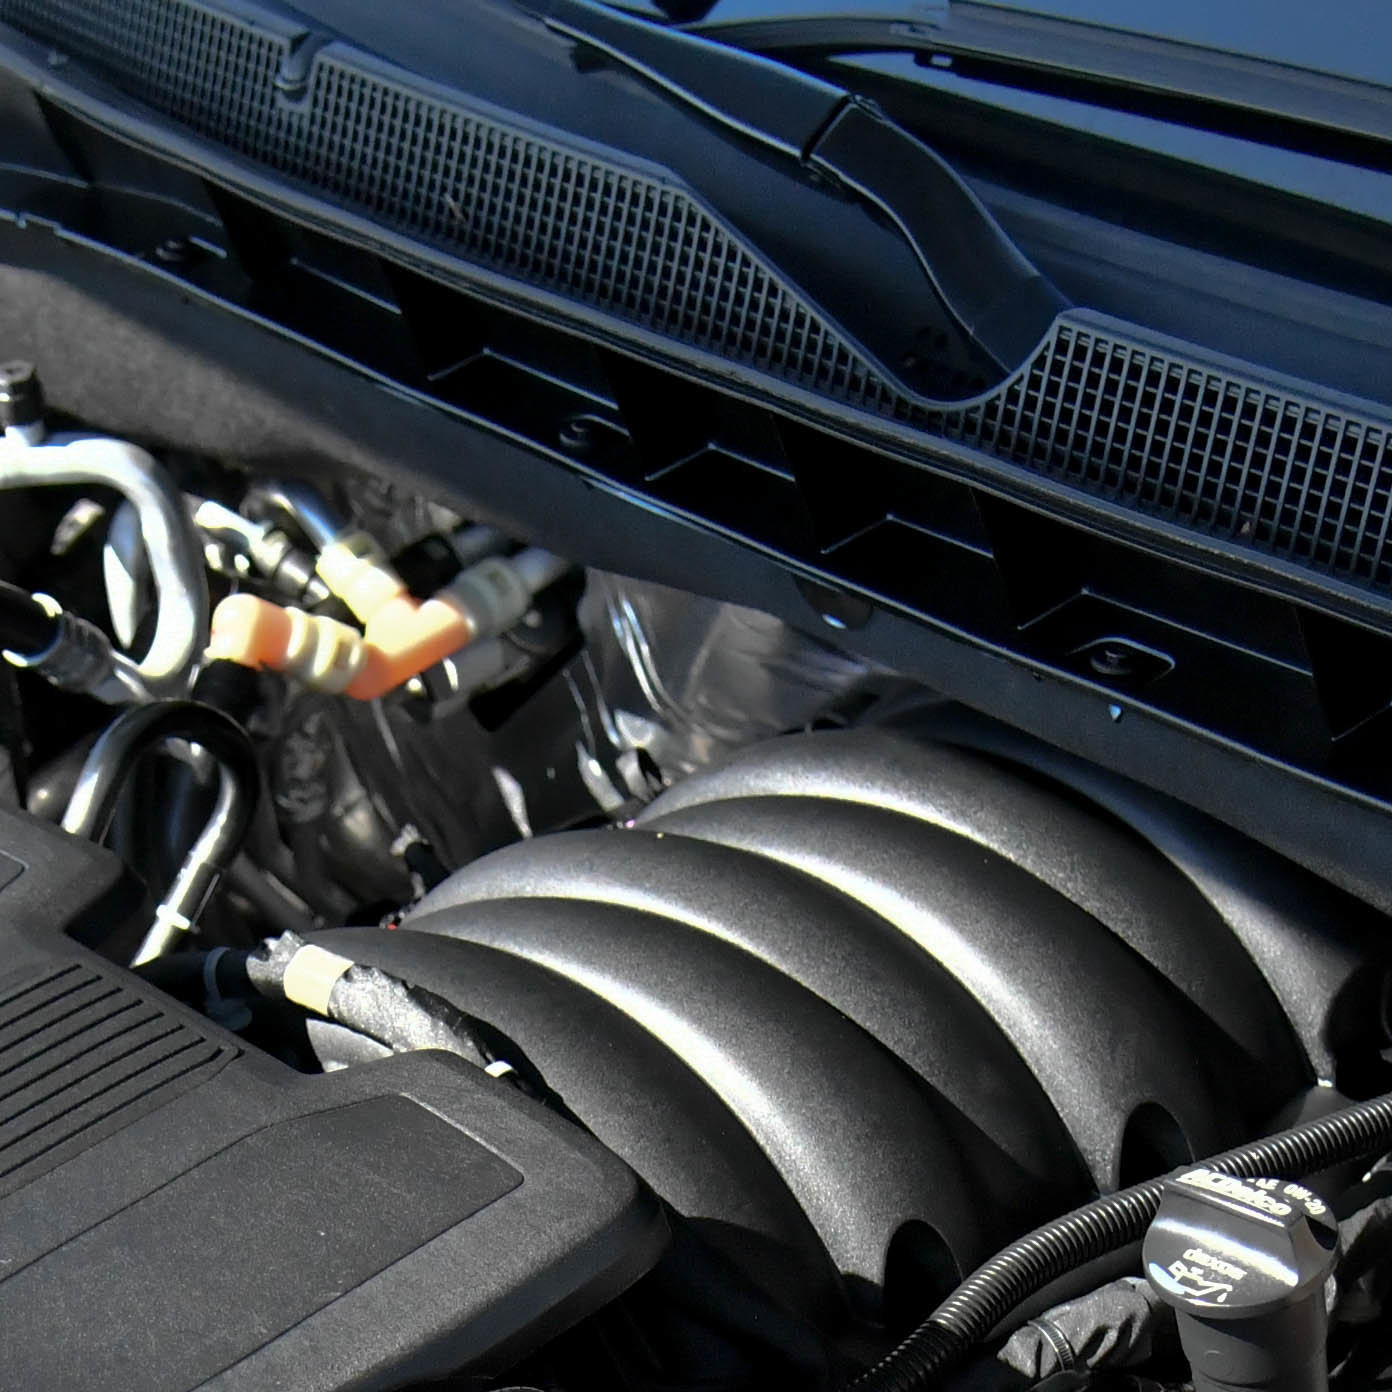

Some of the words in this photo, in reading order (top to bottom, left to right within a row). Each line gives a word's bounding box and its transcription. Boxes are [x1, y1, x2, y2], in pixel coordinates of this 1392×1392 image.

[1176, 1168, 1292, 1216] ACDelco
[1247, 1178, 1281, 1190] AE
[1283, 1183, 1327, 1215] 0W-20
